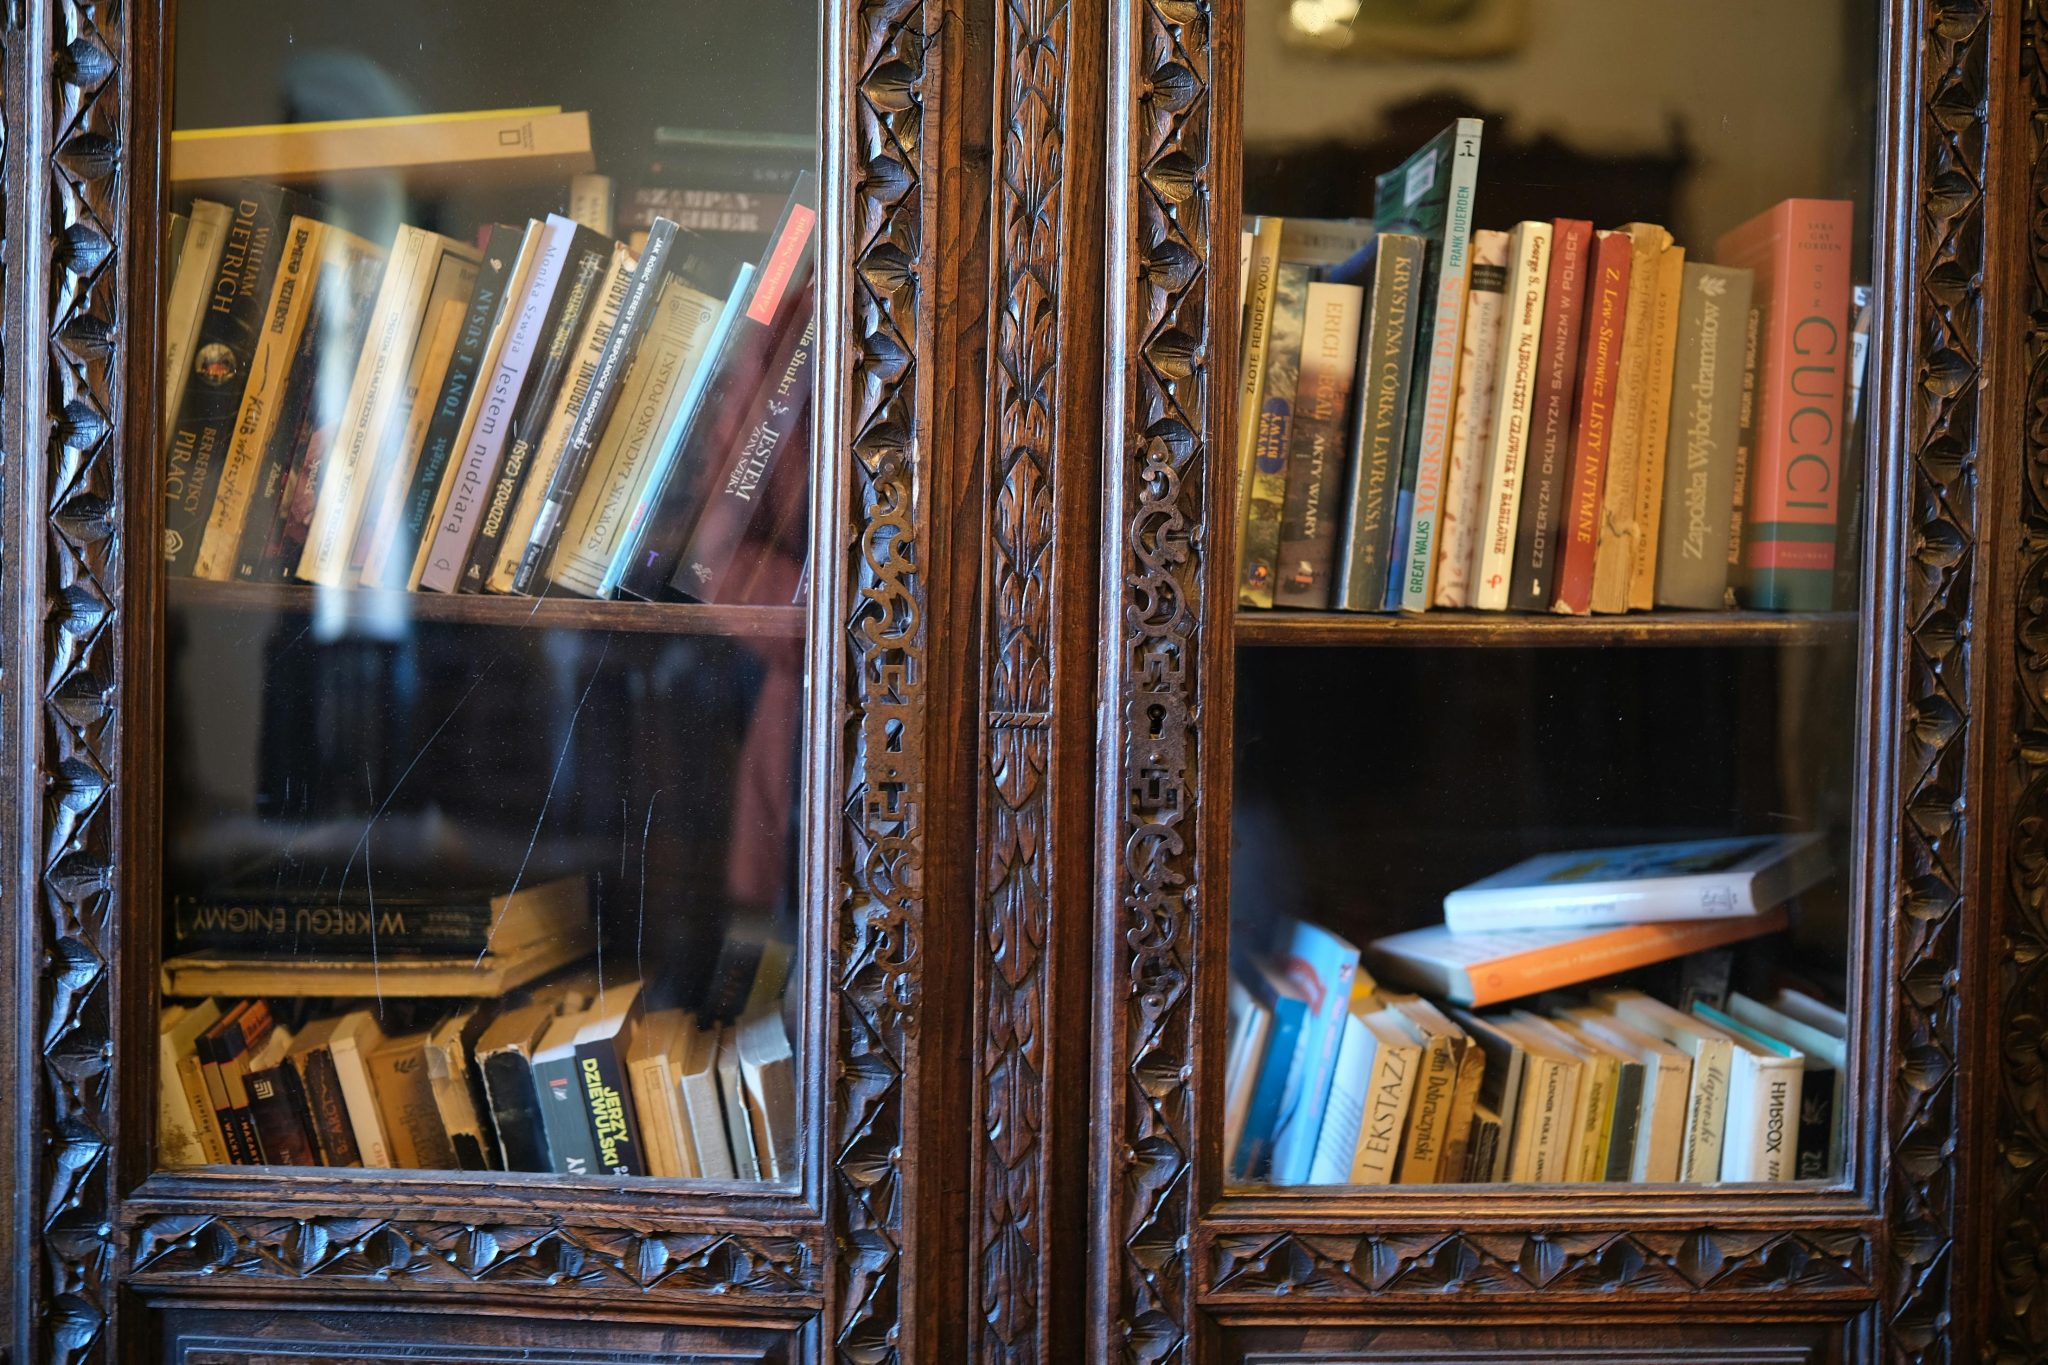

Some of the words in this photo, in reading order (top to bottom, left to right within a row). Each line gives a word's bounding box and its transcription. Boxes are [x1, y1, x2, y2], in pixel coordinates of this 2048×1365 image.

[1454, 185, 1470, 233] DUERDEN
[212, 199, 258, 314] DIETRICH
[239, 227, 270, 297] WILLIAM
[530, 245, 558, 300] Monika
[653, 237, 663, 256] JAK
[1449, 234, 1465, 268] FRANK
[1526, 235, 1545, 273] George
[1562, 231, 1579, 291] POLSCE
[1605, 267, 1620, 284] Z.
[626, 281, 646, 323] INTERESY
[757, 255, 785, 313] Zakochany
[1251, 255, 1272, 352] RENDEZ-VOUS
[1385, 255, 1412, 357] KRYSTYNA
[1559, 297, 1571, 309] W
[465, 288, 494, 348] SUSAN
[511, 304, 537, 354] Szwaja
[589, 320, 614, 355] KARY
[618, 322, 630, 337] WE
[1321, 301, 1344, 360] ERICH
[1433, 276, 1460, 359] DALES
[1593, 288, 1619, 397] Lew-Starowicz
[459, 354, 473, 365] I
[777, 346, 807, 396] Shukri
[1245, 354, 1261, 395] ZŁOTE
[1551, 313, 1569, 390] SATANIZM
[1692, 300, 1721, 399] dramatów
[240, 395, 264, 436] KLUB
[442, 368, 468, 417] TONY
[481, 362, 518, 435] Jestem
[573, 386, 602, 450] EUROPEJSKIEJ
[1375, 361, 1399, 430] CÓRKA
[1785, 315, 1839, 510] GUCCI
[1256, 411, 1271, 458] WYSPA
[1266, 412, 1282, 460] BITWY
[1415, 365, 1451, 515] YORKSHIRE
[1542, 395, 1561, 475] OKULTYZM
[1587, 401, 1606, 451] LISTY
[1687, 399, 1716, 471] Wybór
[165, 430, 197, 501] PIRACI
[422, 436, 448, 488] Wright
[725, 456, 749, 495] SZEJKA
[736, 421, 780, 502] JESTEM
[1310, 433, 1326, 480] AKTY
[1364, 435, 1390, 533] LAVRANSA
[408, 488, 431, 534] Austin
[443, 445, 488, 535] nudziarą
[482, 476, 515, 538] ROZDROŻA
[504, 439, 529, 478] CZASU
[1303, 481, 1321, 539] WIARY
[1577, 455, 1600, 544] INTYMNE
[1682, 470, 1711, 561] Zapolska
[587, 484, 625, 552] SŁOWNIK
[1413, 519, 1430, 558] WALKS
[1532, 480, 1552, 569] EZOTERYZM
[1409, 559, 1425, 594] GREAT
[193, 906, 286, 934] ENIGMY
[377, 911, 405, 935] W
[1431, 1047, 1450, 1073] Jan
[582, 1057, 619, 1167] DZIEWULSKI
[603, 1086, 629, 1143] JERZY
[1413, 1076, 1448, 1162] Dobraczyński
[1766, 1081, 1787, 1154] ХОЗЯИН
